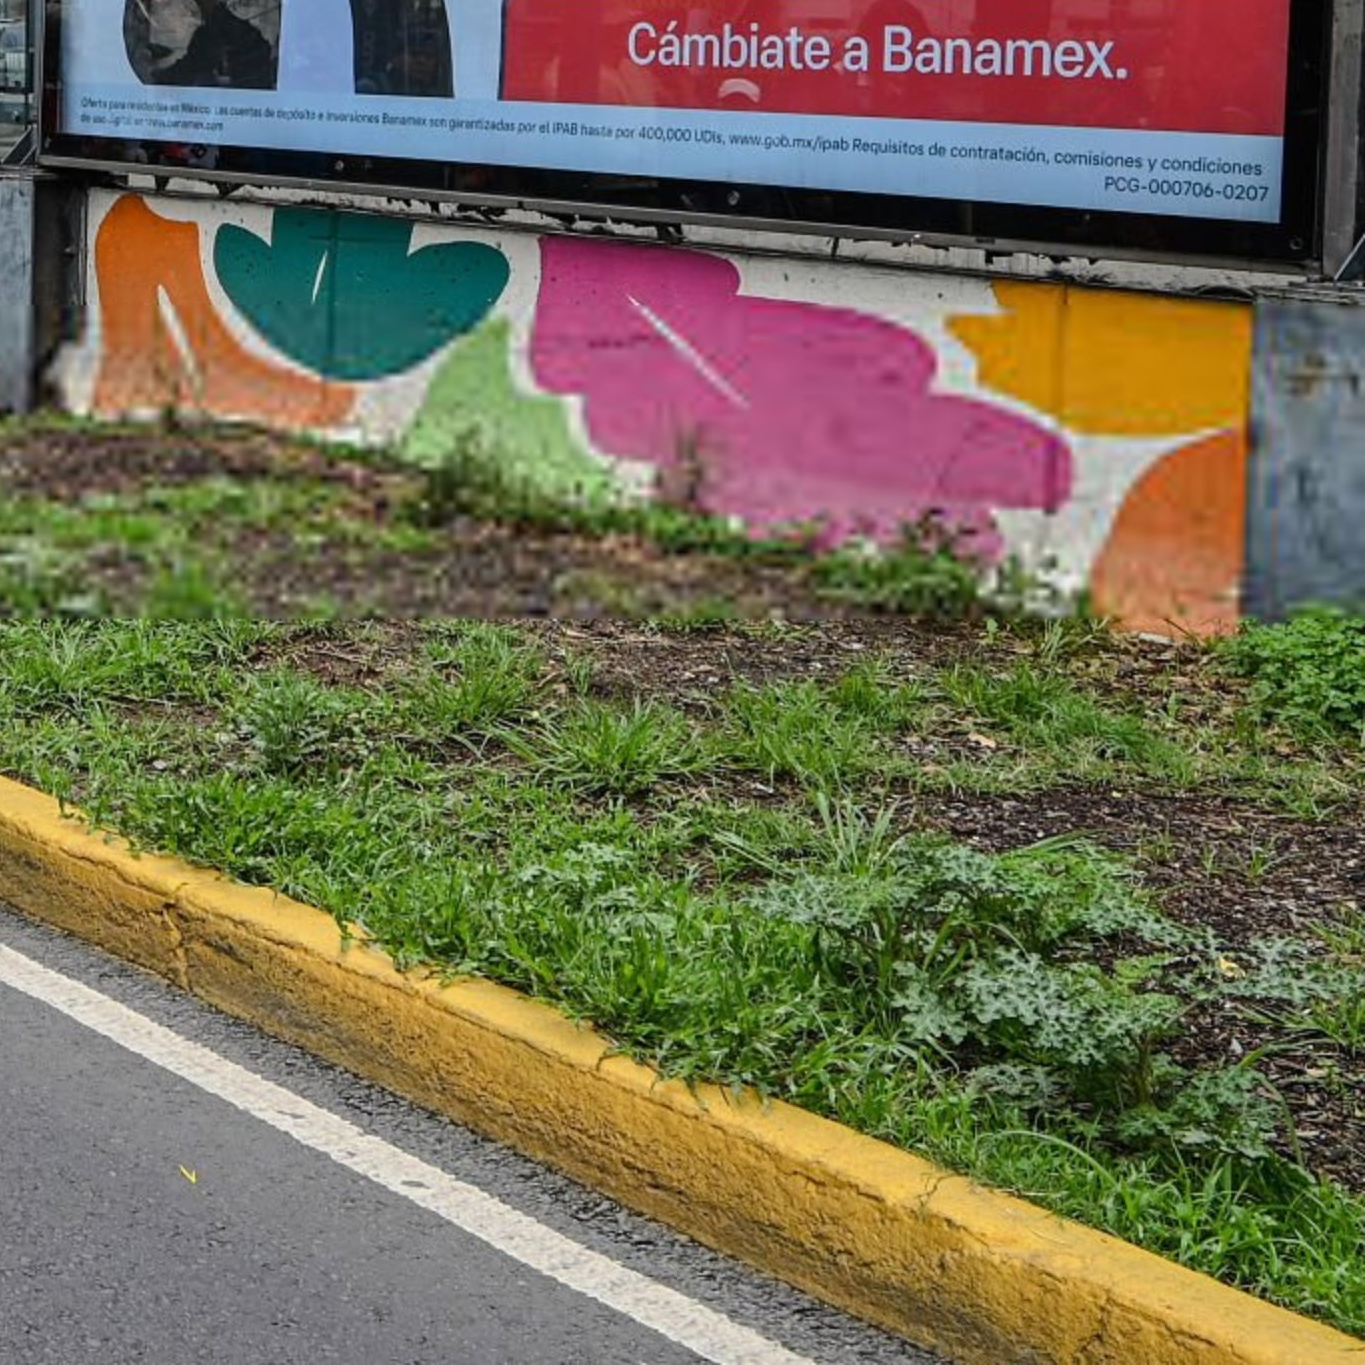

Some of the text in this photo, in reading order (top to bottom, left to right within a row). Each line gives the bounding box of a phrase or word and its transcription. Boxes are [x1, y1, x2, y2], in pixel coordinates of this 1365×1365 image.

[627, 20, 1129, 81] Cámbiate a Banamex.
[264, 108, 275, 119] de
[382, 112, 426, 126] Banamex
[429, 118, 447, 128] son
[448, 118, 516, 132] garantizadas
[517, 122, 536, 134] por
[539, 122, 550, 134] el
[552, 122, 578, 136] IPAB
[580, 124, 613, 138] hasta
[615, 127, 635, 140] por
[638, 126, 692, 143] 400,000
[728, 133, 849, 154] www.gob.mx/ipab
[852, 138, 924, 156] Requisitos
[928, 142, 946, 157] de
[950, 146, 1050, 165] contratación,
[1054, 150, 1142, 170] comisiones
[1147, 158, 1157, 172] y
[1161, 156, 1263, 176] condiciones
[1104, 175, 1270, 202] PCG-000706-0207
